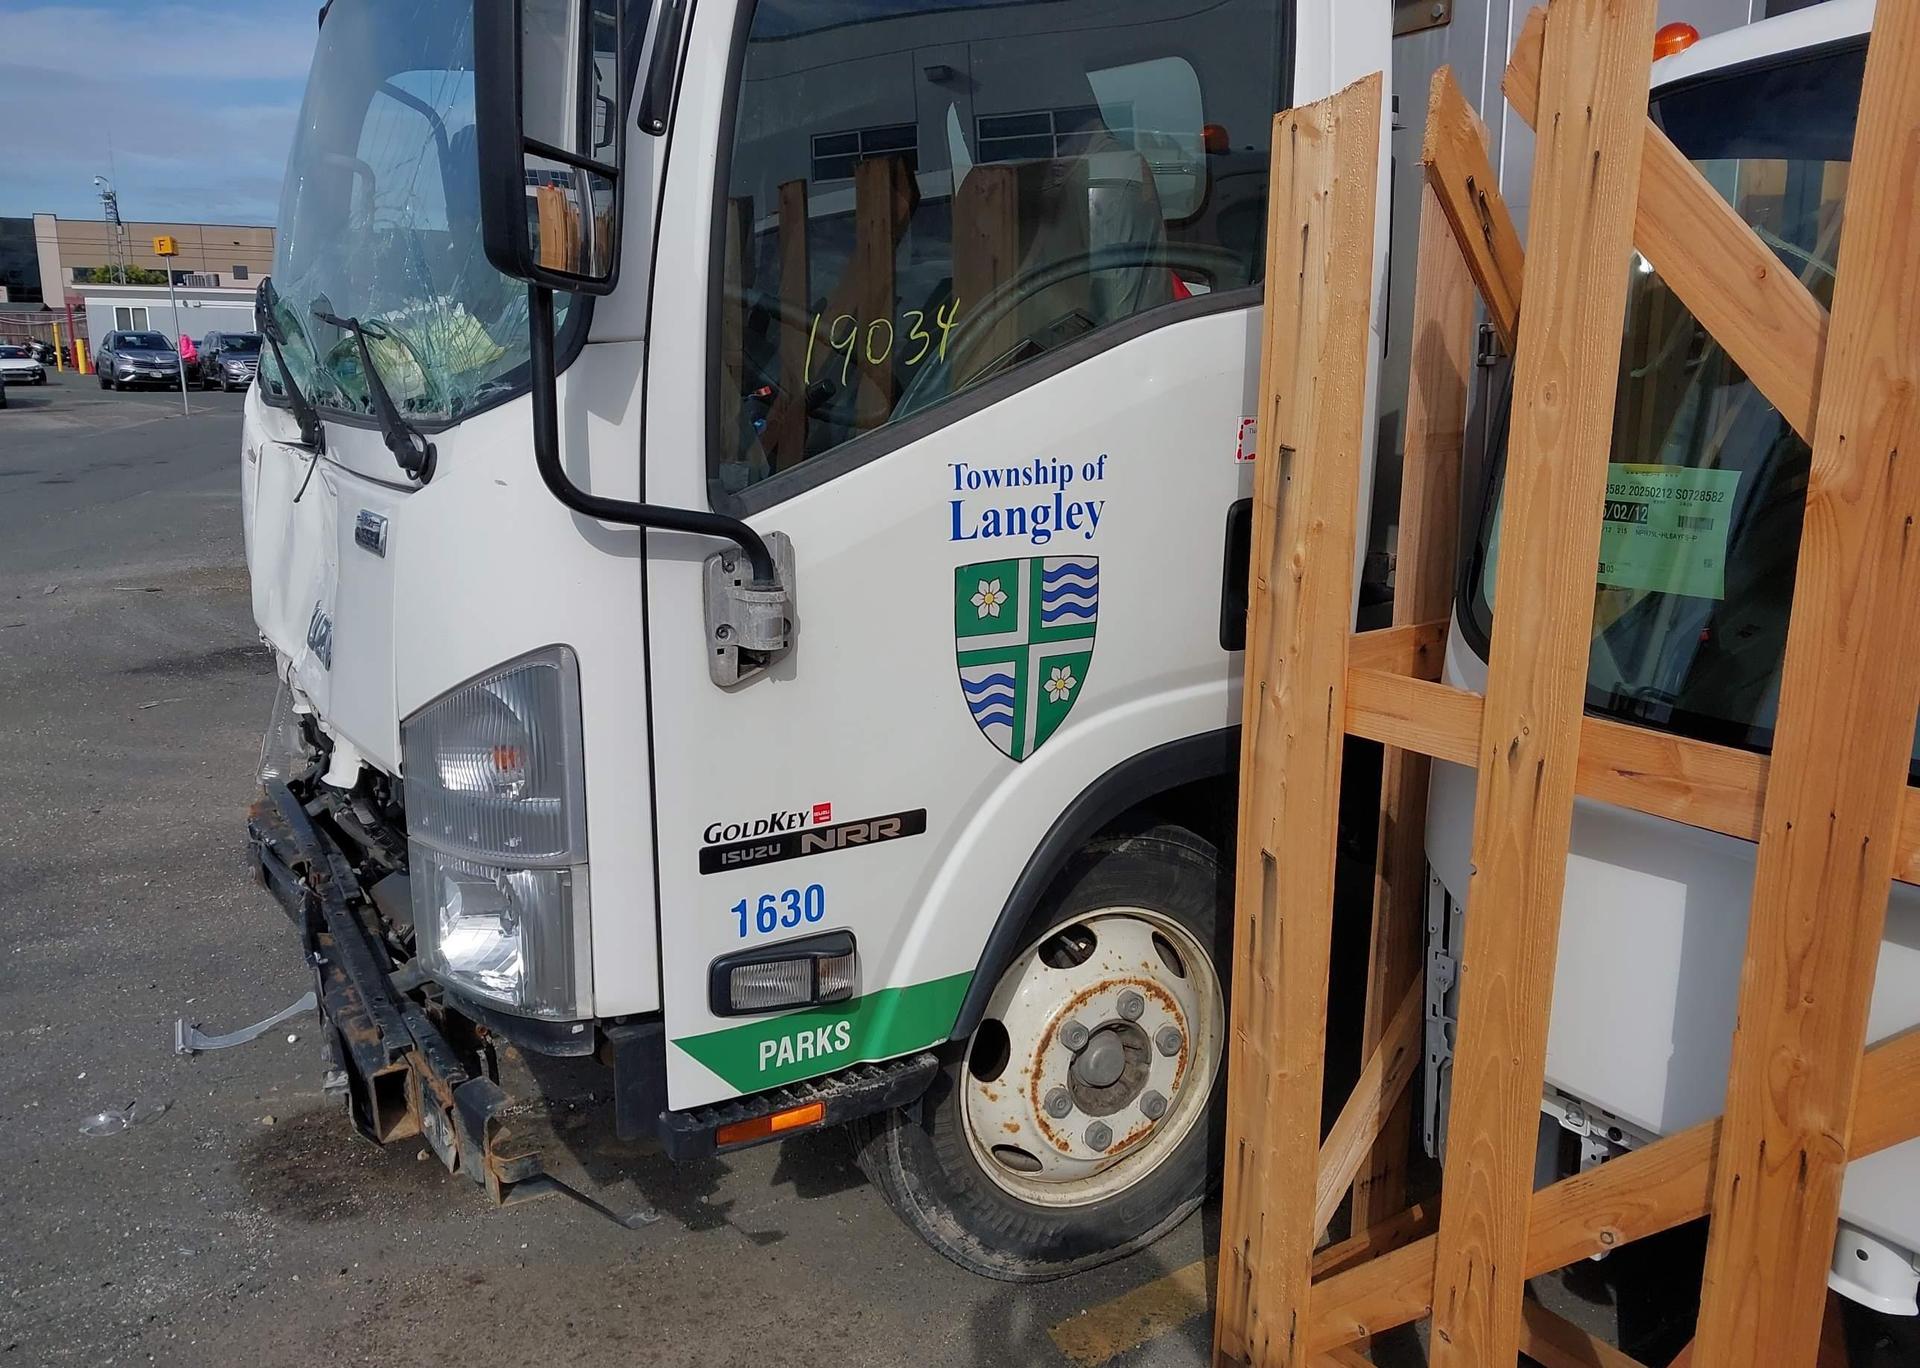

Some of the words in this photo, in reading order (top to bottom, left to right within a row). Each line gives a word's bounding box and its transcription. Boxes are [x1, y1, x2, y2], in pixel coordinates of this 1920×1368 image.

[159, 239, 166, 251] F
[804, 297, 960, 387] 19034
[948, 457, 1074, 491] Township
[1082, 454, 1108, 482] of
[1629, 485, 1672, 499] 20250212
[1675, 488, 1724, 503] S0728582
[948, 492, 1106, 545] Langley
[721, 843, 781, 865] ISUZU
[801, 817, 901, 854] NRR
[731, 883, 825, 938] 1630
[759, 1020, 851, 1072] PARKS
